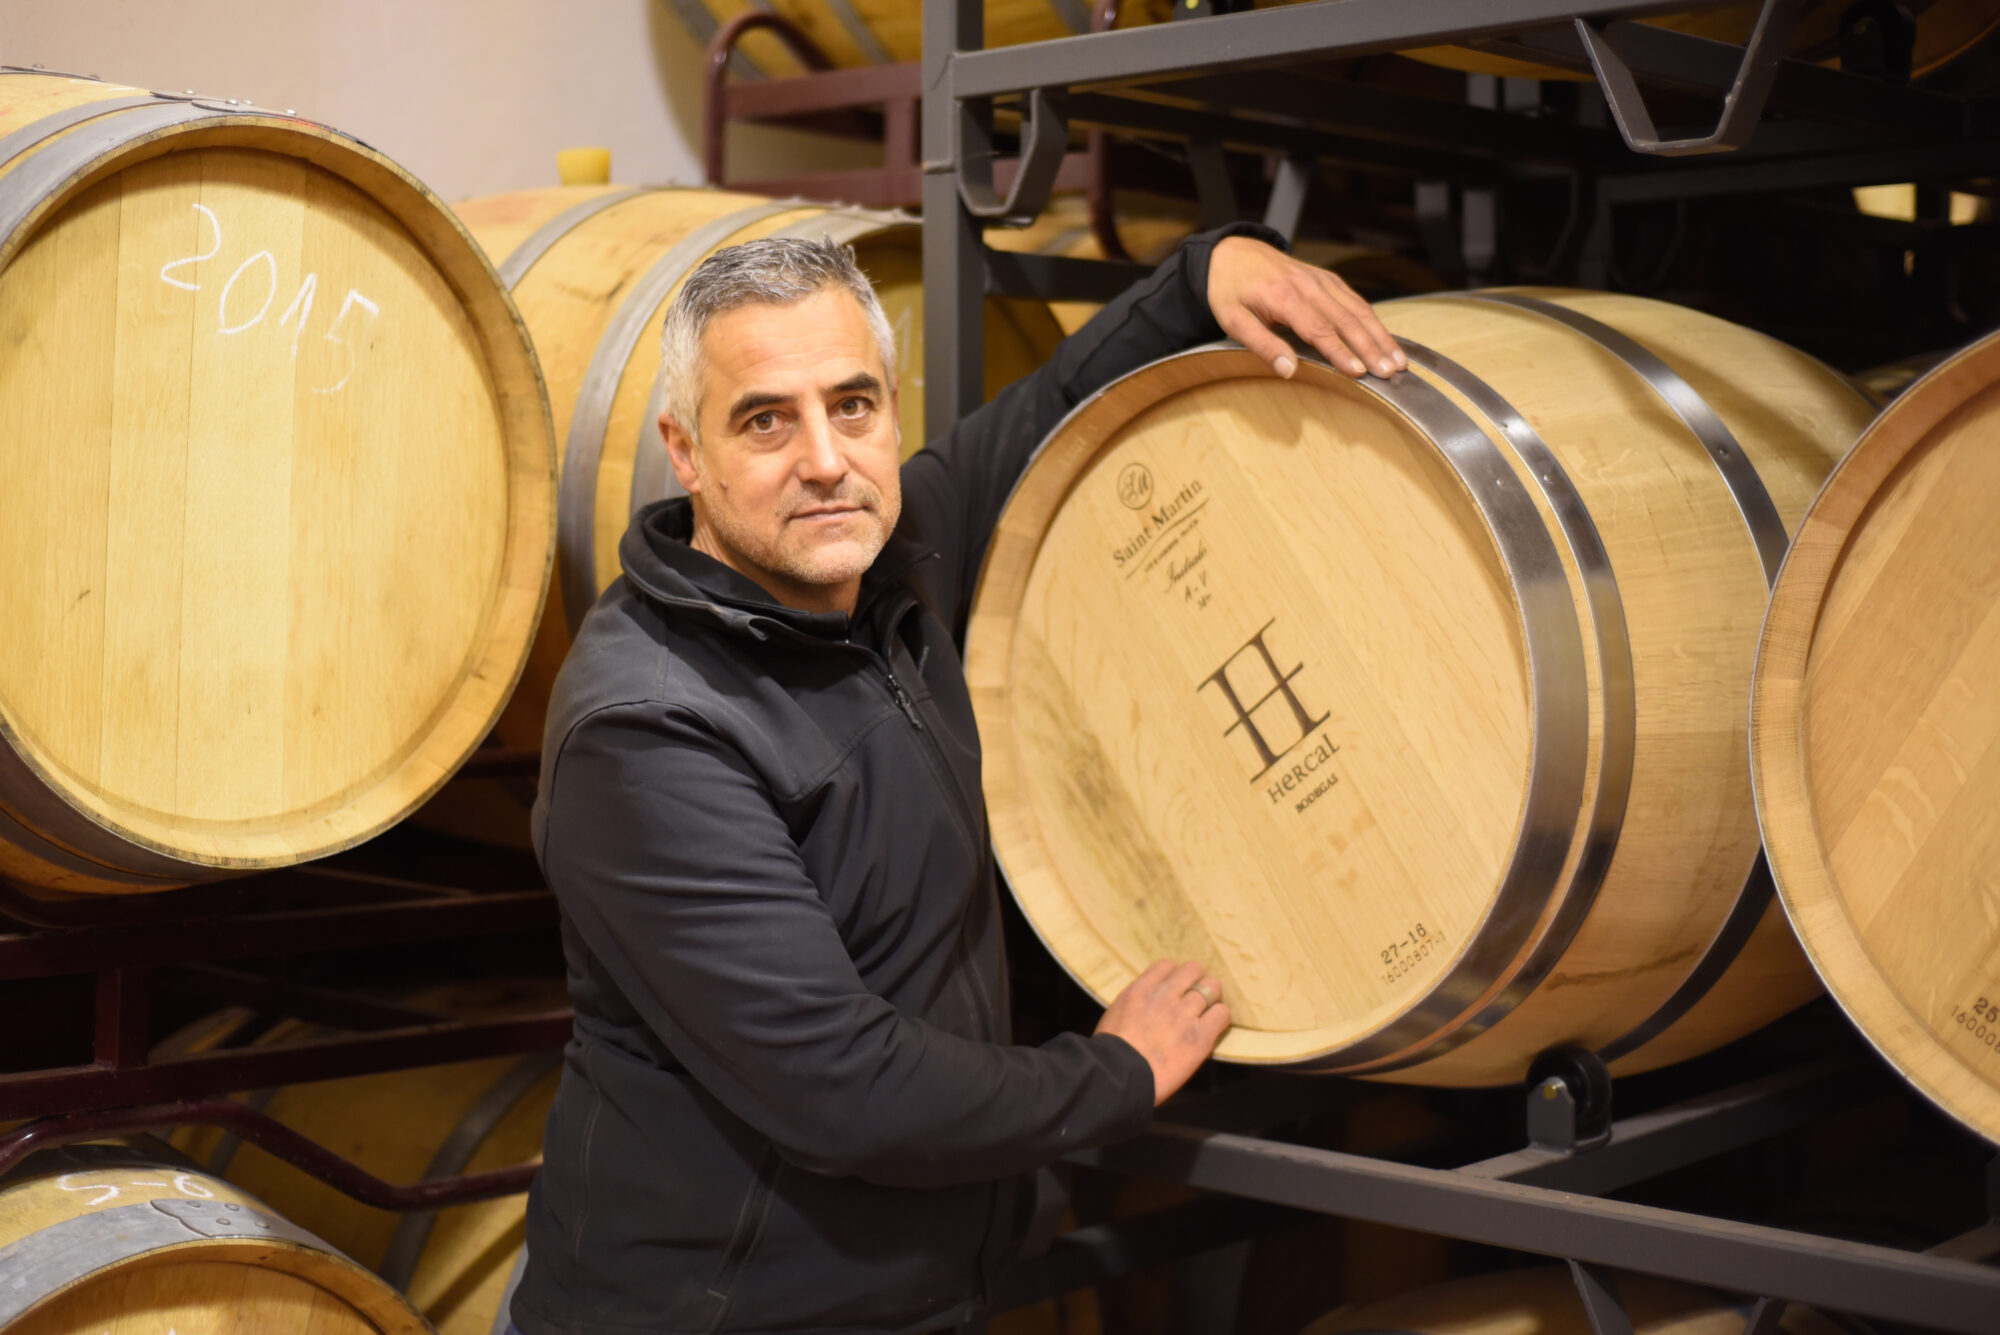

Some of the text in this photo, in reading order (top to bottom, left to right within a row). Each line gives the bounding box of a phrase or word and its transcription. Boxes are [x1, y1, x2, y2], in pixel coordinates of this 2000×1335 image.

[160, 202, 380, 394] 2015
[1112, 526, 1154, 568] Saint
[1151, 478, 1203, 531] Martin
[1196, 617, 1331, 785] H
[1295, 773, 1339, 815] BODEGAS
[1380, 922, 1427, 965] 27-16
